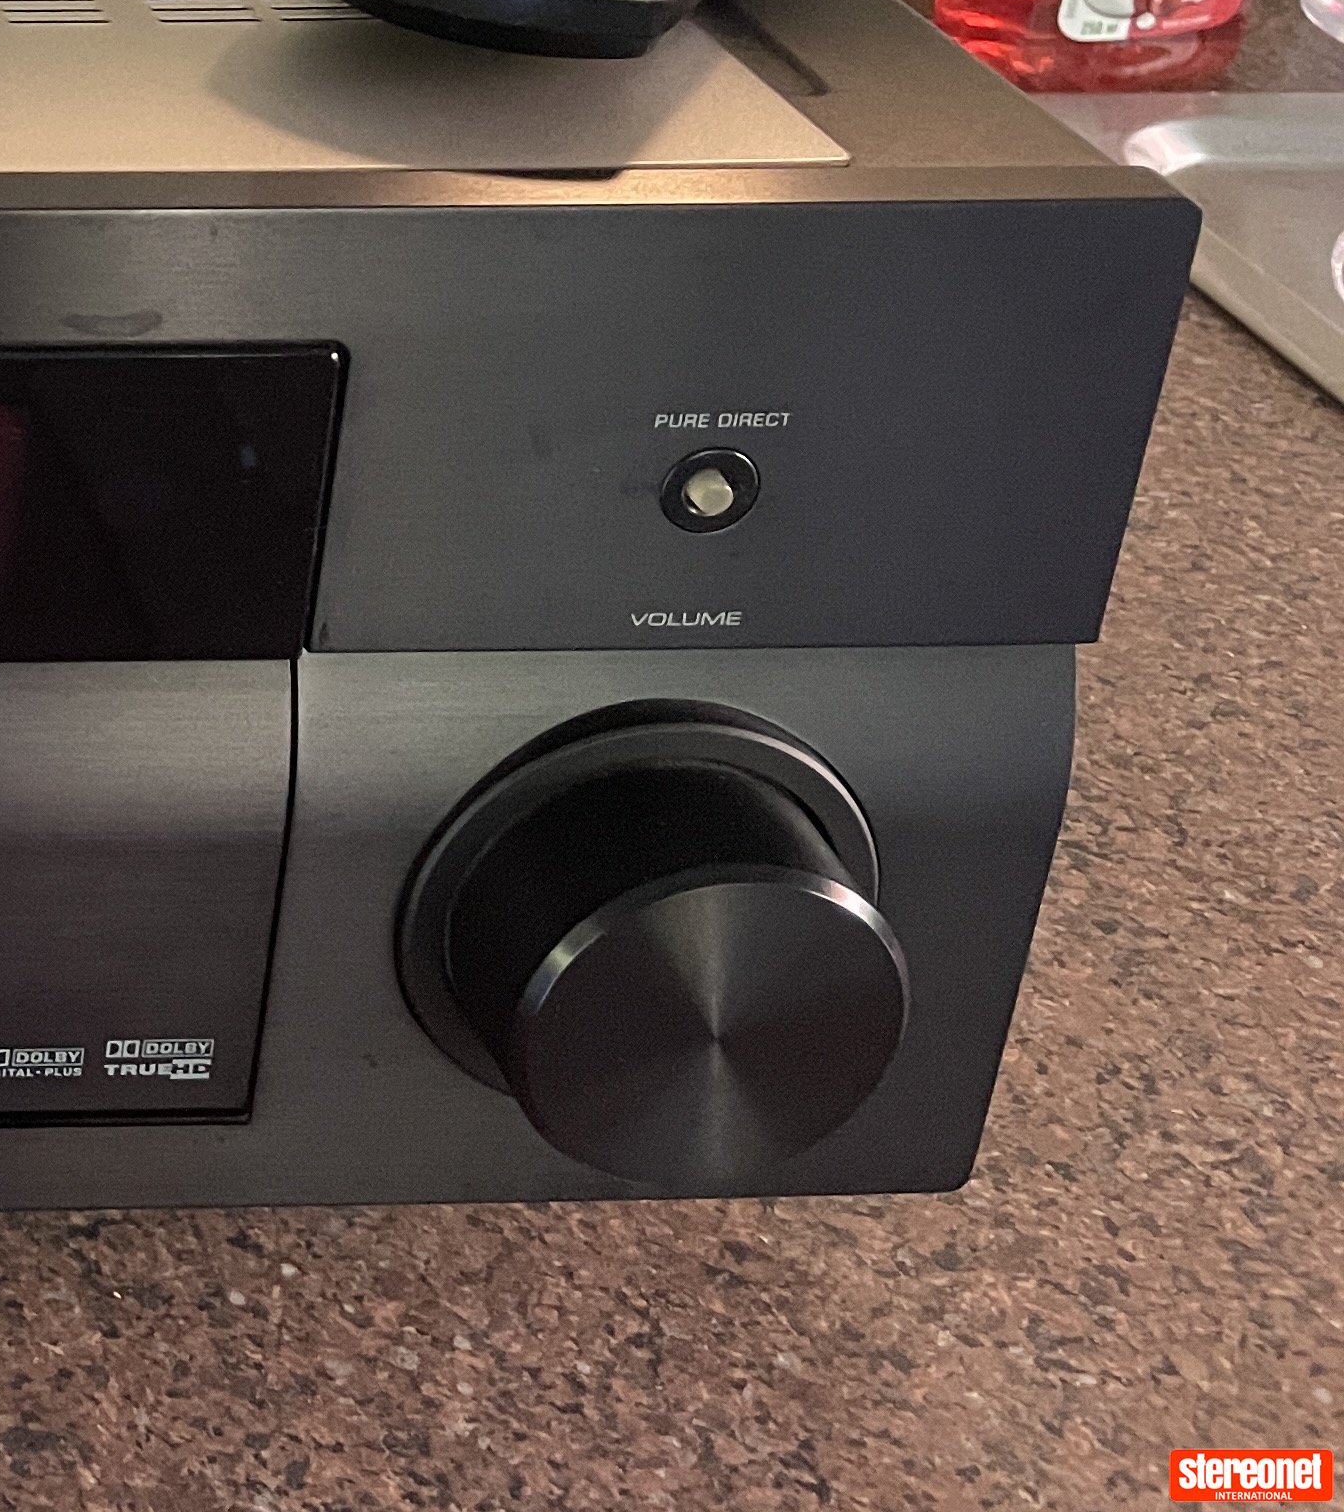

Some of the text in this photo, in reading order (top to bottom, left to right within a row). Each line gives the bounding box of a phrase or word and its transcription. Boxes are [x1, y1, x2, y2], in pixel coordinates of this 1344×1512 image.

[654, 412, 790, 428] PURE DIRECT
[631, 611, 742, 627] VOLUME
[145, 1042, 210, 1054] DOLBY
[15, 1050, 81, 1063] DOLBY
